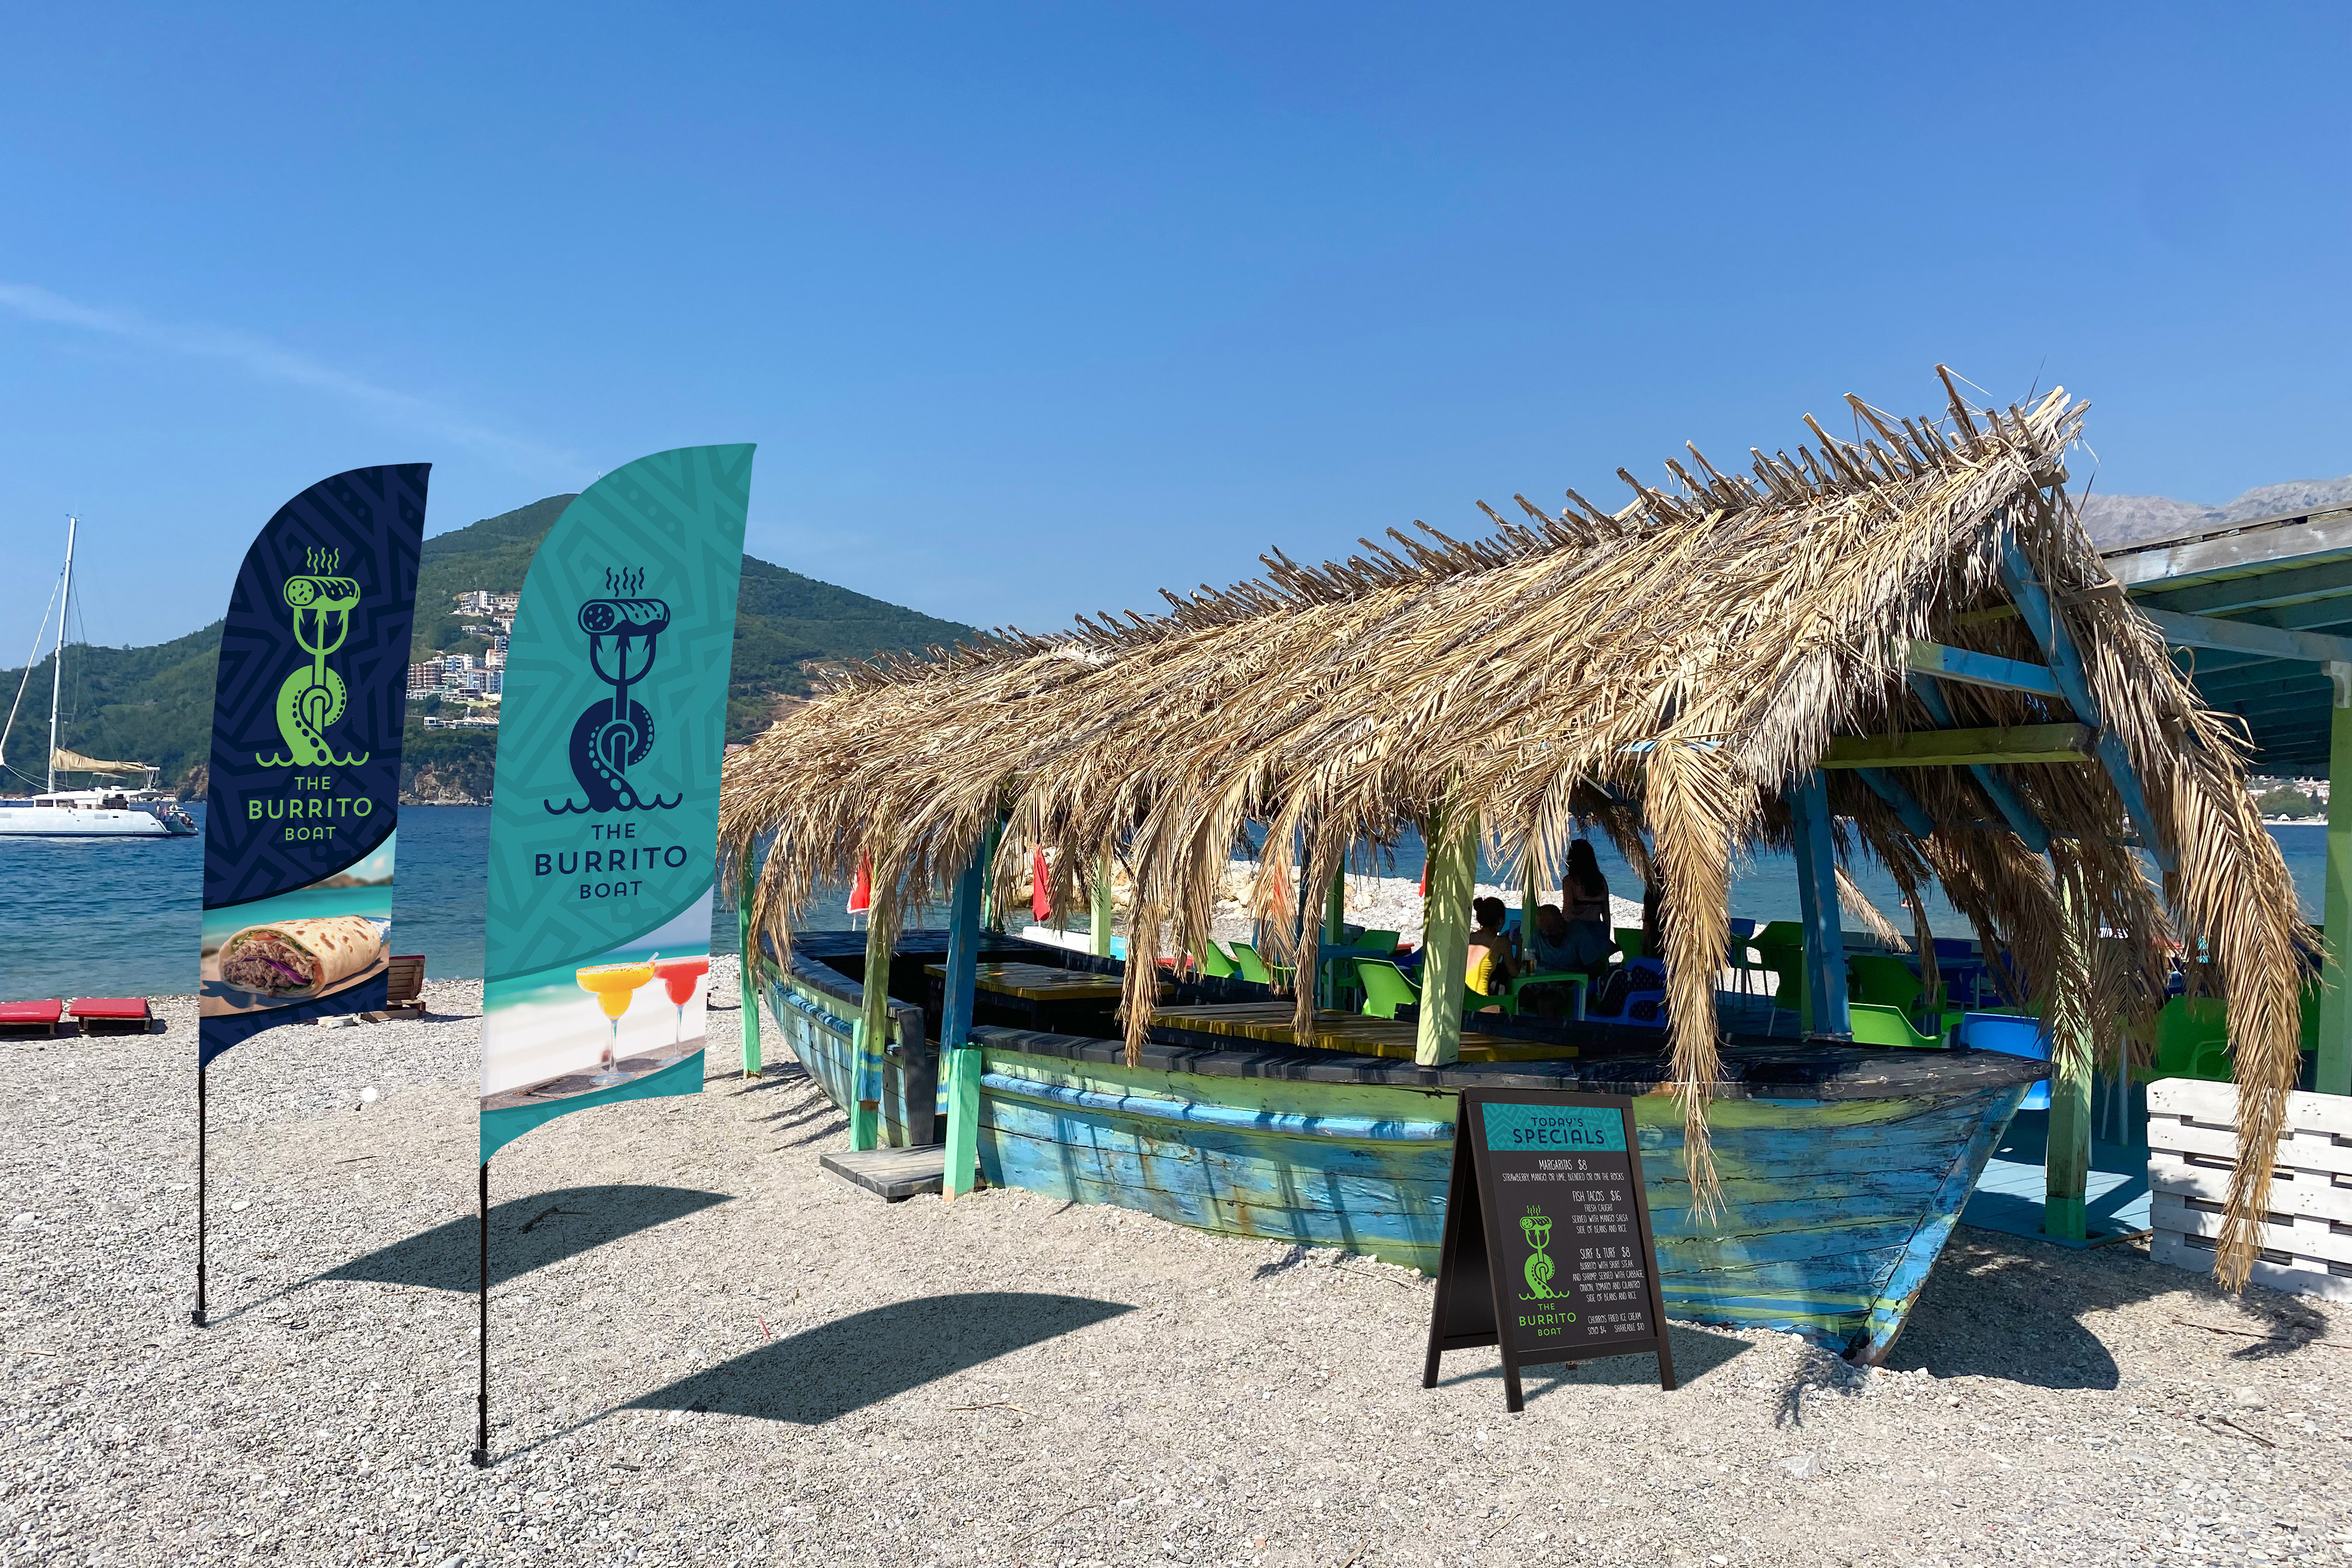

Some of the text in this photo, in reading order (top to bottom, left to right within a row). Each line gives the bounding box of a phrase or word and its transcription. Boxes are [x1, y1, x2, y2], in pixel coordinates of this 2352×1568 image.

[295, 776, 331, 790] THE
[249, 797, 372, 820] BURRITO
[285, 827, 336, 841] BOAT
[591, 822, 635, 840] THE
[536, 845, 687, 876] BURRITO
[580, 880, 642, 899] BOAT
[1531, 1117, 1583, 1127] TODAY'S
[1513, 1128, 1605, 1144] SPECIALS
[1539, 1159, 1587, 1171] MARGARITAS $8
[1502, 1173, 1530, 1182] STRAWBERRY,
[1531, 1173, 1548, 1182] MANGO,
[1567, 1172, 1585, 1181] BLENDED
[1586, 1172, 1593, 1181] OR
[1594, 1172, 1601, 1181] ON
[1610, 1172, 1625, 1181] ROCKS
[1572, 1190, 1621, 1202] FISH TACOS $16
[1584, 1203, 1613, 1212] FRESH CAUGHT
[1572, 1214, 1629, 1223] SERVED WITH MANGO SALSA
[1576, 1224, 1627, 1234] SIDE OF BEANS AND RICE
[1580, 1246, 1630, 1259] SURF & TURF $8
[1580, 1259, 1634, 1270] BURRITO WITH SKIRT STEAK
[1572, 1273, 1581, 1282] AND
[1598, 1271, 1614, 1280] SERVED
[1614, 1270, 1626, 1279] WITH
[1595, 1282, 1611, 1291] TOMATO
[1612, 1282, 1621, 1290] AND
[1622, 1280, 1640, 1289] CILANTRO
[1586, 1291, 1637, 1303] SIDE OF BEANS AND RICE
[1538, 1303, 1555, 1311] THE
[1519, 1312, 1576, 1326] BURRITO
[1587, 1315, 1608, 1324] CHURROS
[1608, 1314, 1619, 1322] FRIED
[1628, 1312, 1642, 1321] CREAM
[1538, 1328, 1562, 1336] BOAT
[1587, 1322, 1645, 1335] SOLO $4 SHAREABLE $10
